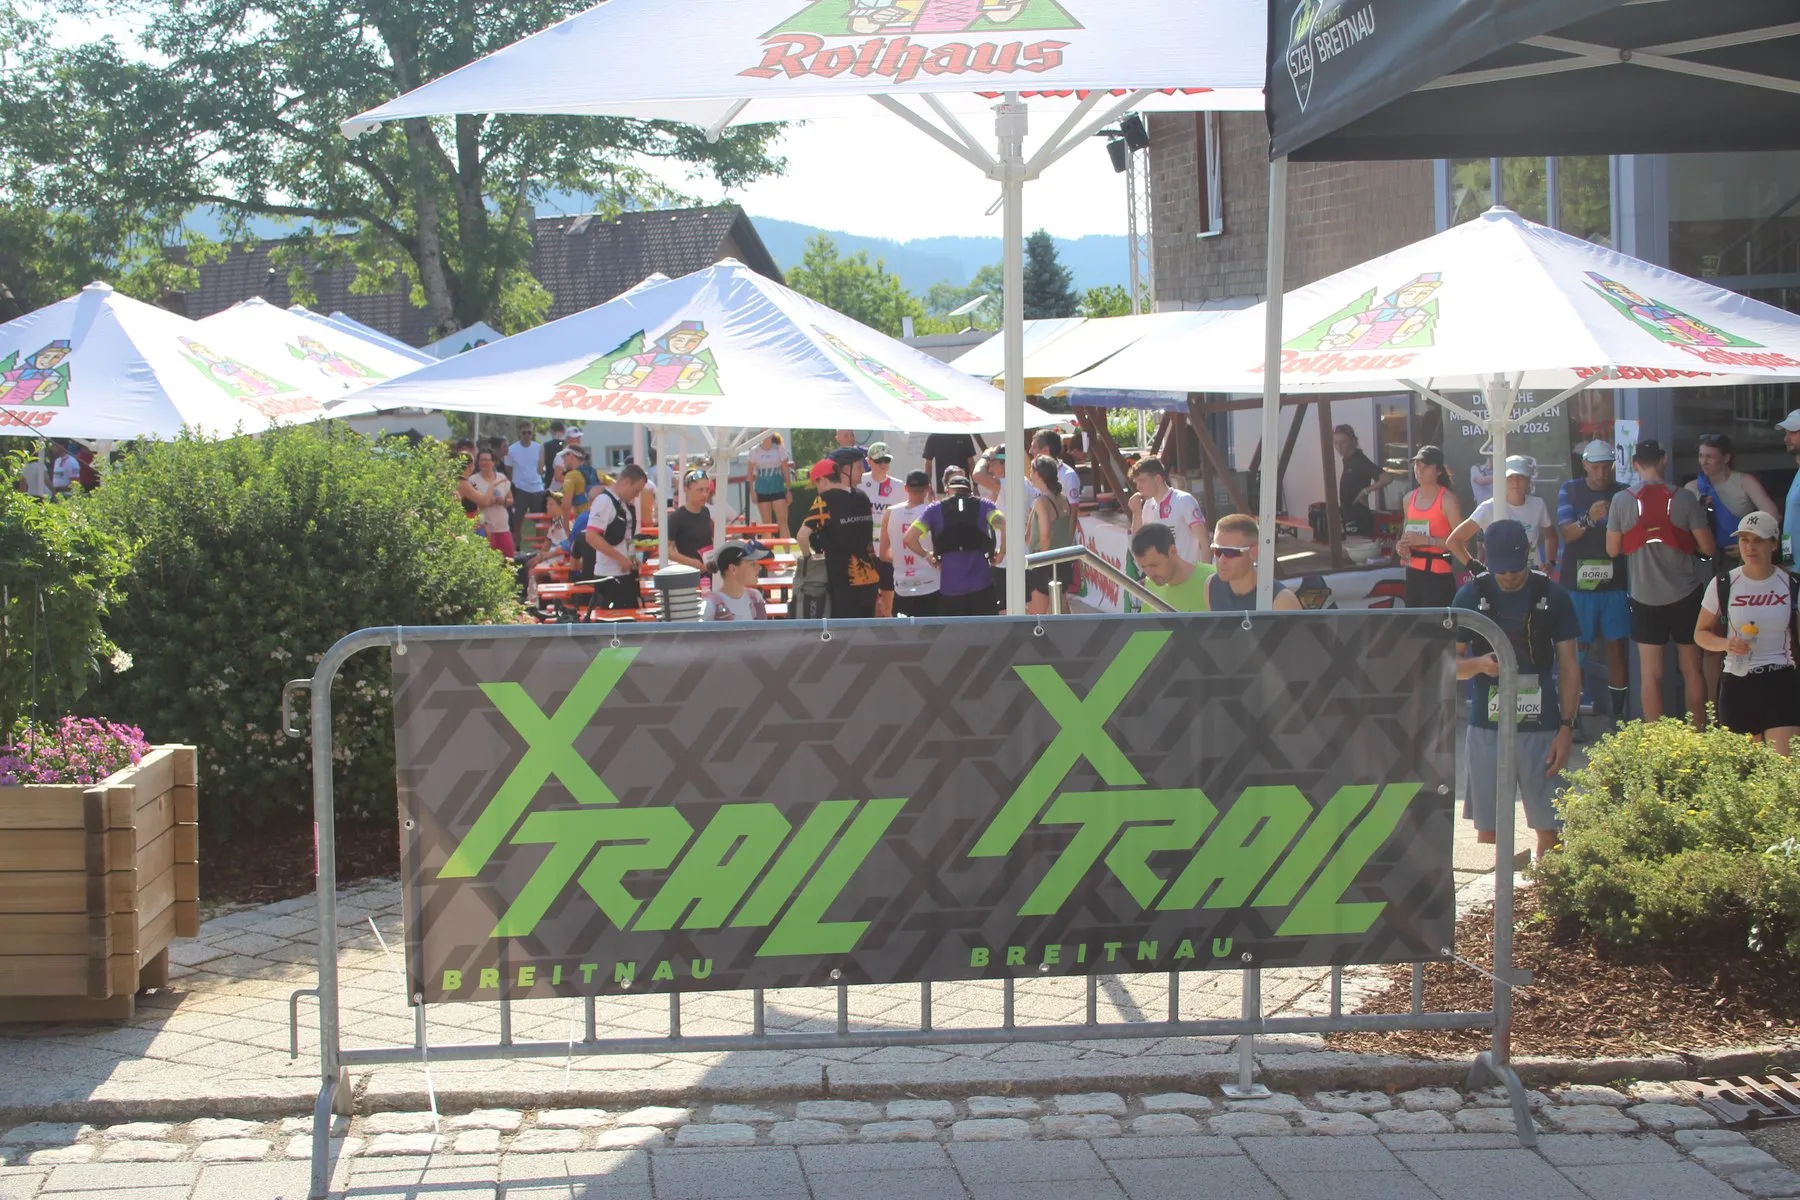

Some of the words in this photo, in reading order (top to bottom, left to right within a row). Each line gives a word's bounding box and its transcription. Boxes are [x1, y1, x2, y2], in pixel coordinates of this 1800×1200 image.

[1315, 4, 1375, 63] BREITNAU
[736, 35, 1072, 84] Rothaus
[1289, 44, 1312, 78] SZB
[538, 384, 713, 416] Rothaus
[1523, 422, 1550, 434] 2026
[1582, 571, 1609, 579] BORIS
[970, 937, 1234, 968] BREITNAU
[442, 958, 714, 991] BREITNAU
